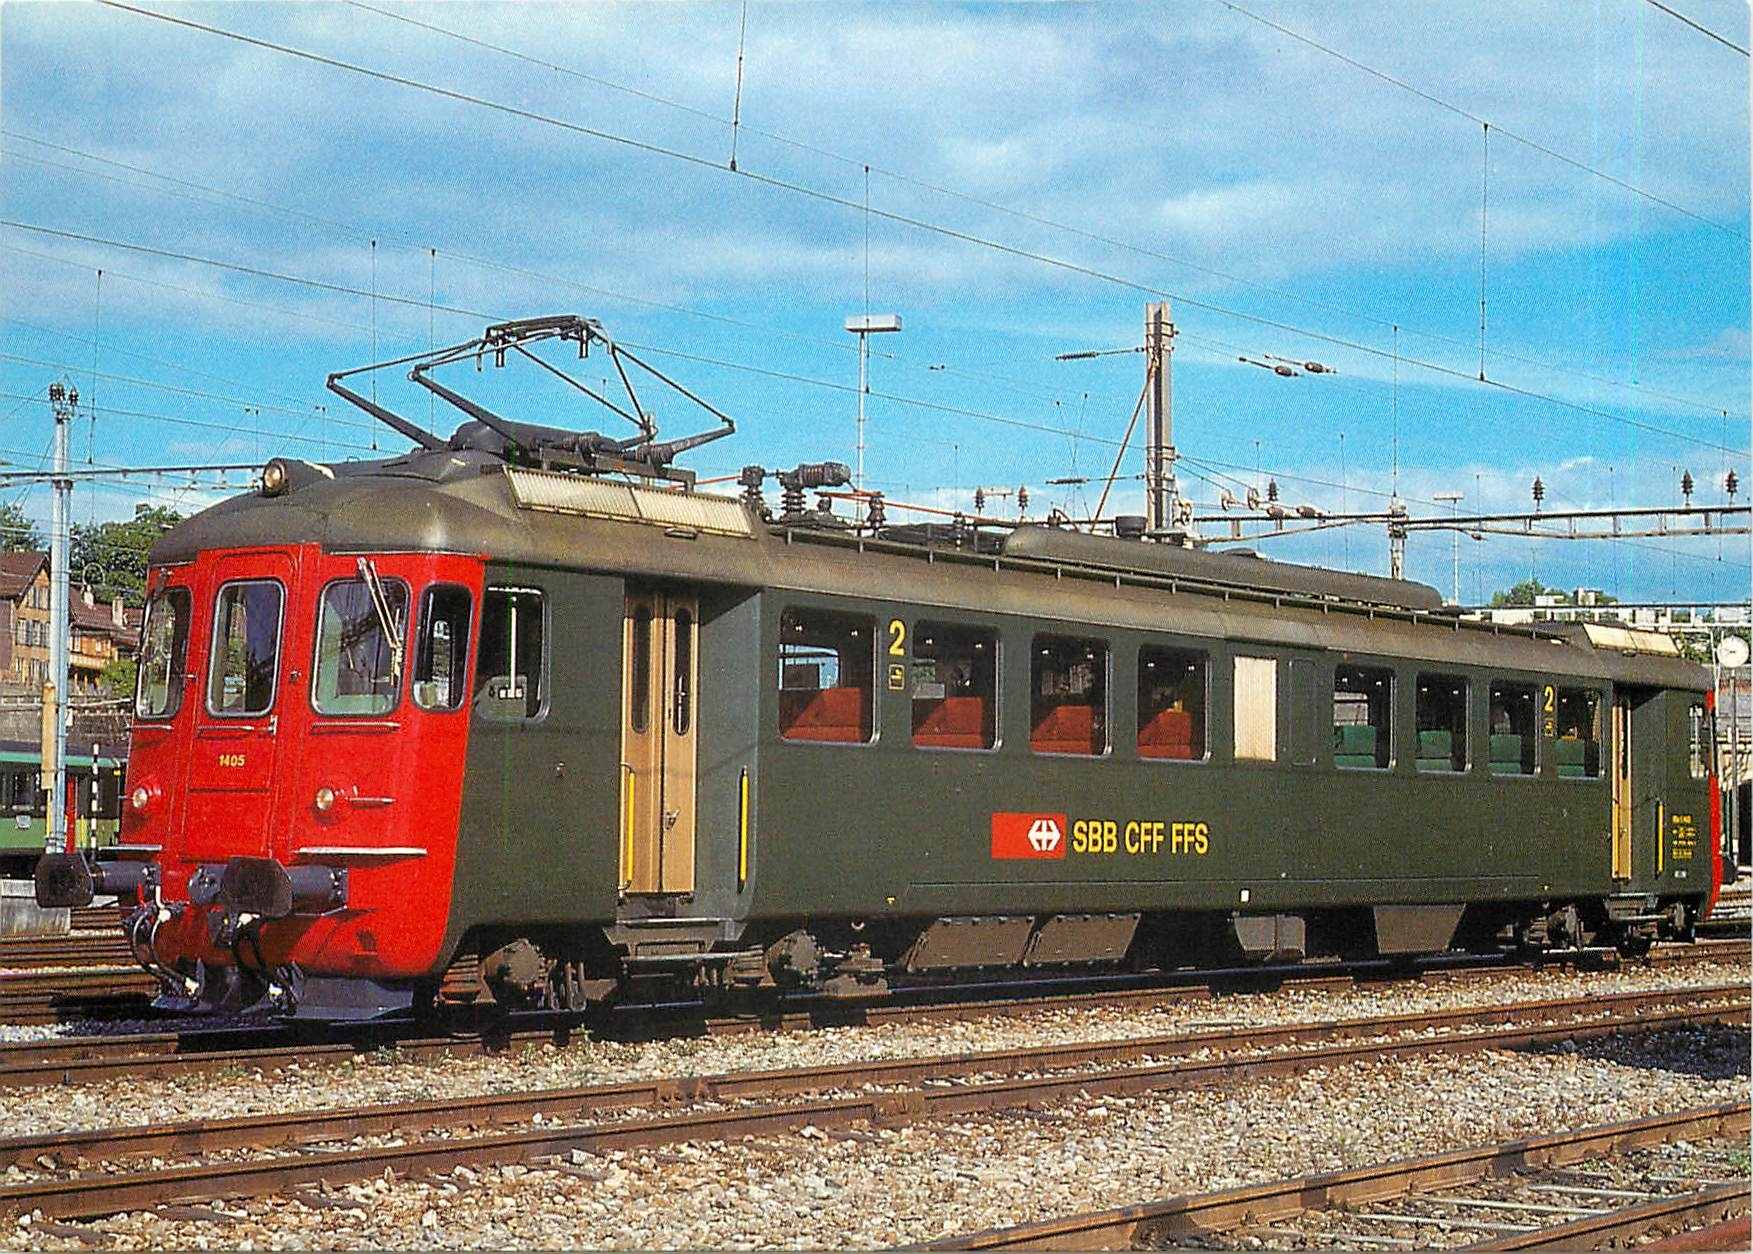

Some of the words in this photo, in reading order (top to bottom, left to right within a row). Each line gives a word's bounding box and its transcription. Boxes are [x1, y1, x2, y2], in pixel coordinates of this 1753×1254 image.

[888, 619, 906, 656] 2
[1544, 686, 1555, 713] 2
[219, 754, 246, 767] 1405
[1072, 820, 1118, 854] SBB
[1125, 821, 1165, 854] CFF
[1171, 823, 1210, 855] FFS
